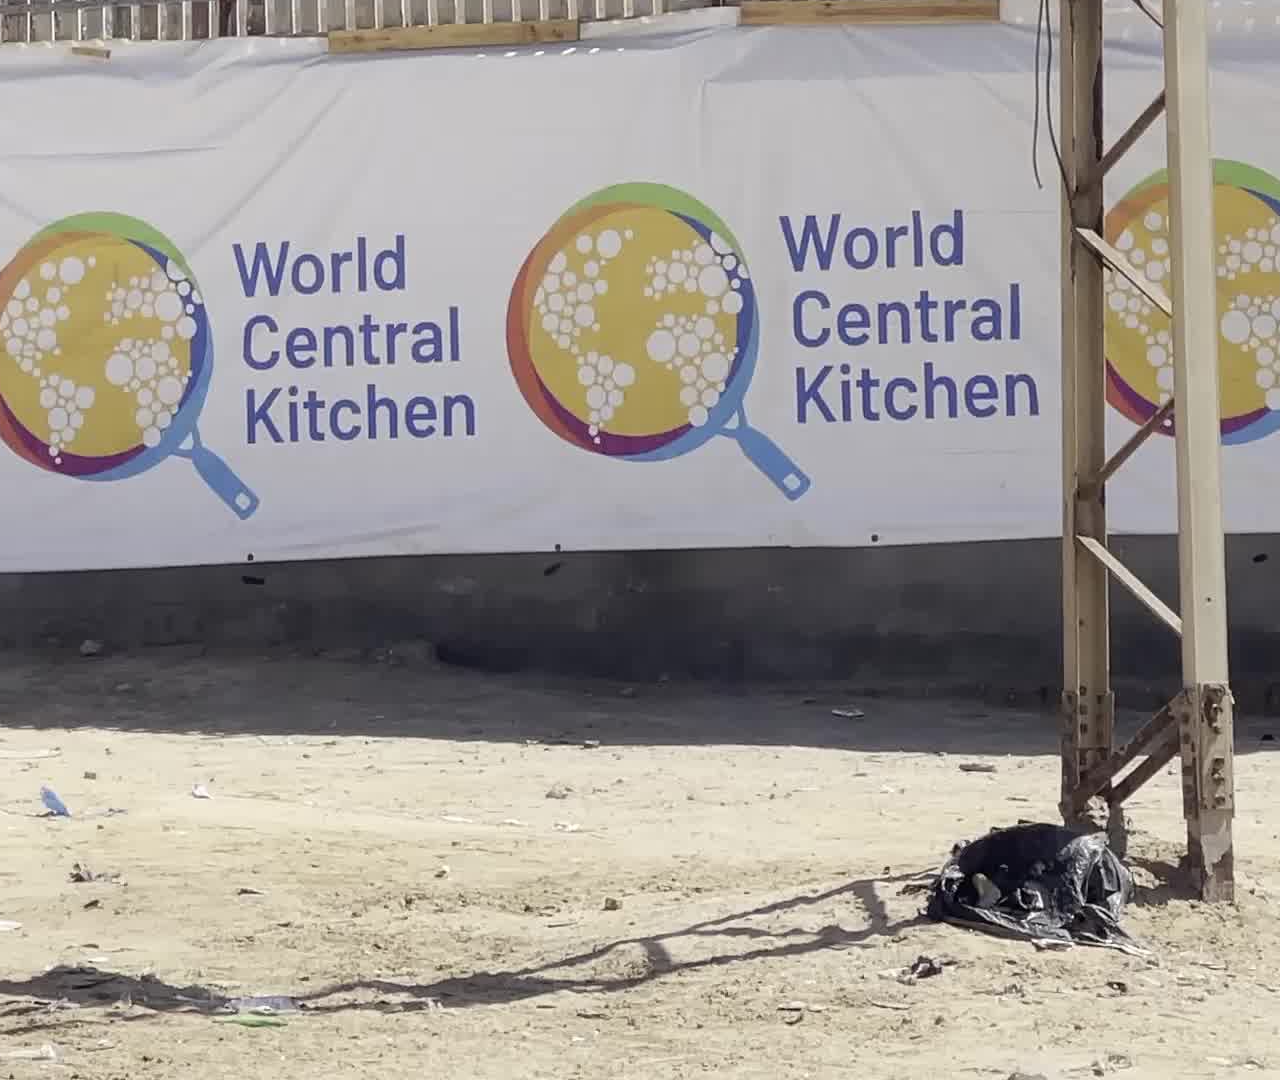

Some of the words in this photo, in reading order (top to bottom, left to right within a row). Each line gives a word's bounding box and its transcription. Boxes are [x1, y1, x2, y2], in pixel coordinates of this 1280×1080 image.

[234, 233, 408, 299] World
[781, 209, 965, 272] World
[243, 308, 460, 371] Central
[792, 286, 1023, 347] Central
[246, 383, 477, 442] Kitchen
[795, 360, 1041, 425] Kitchen
